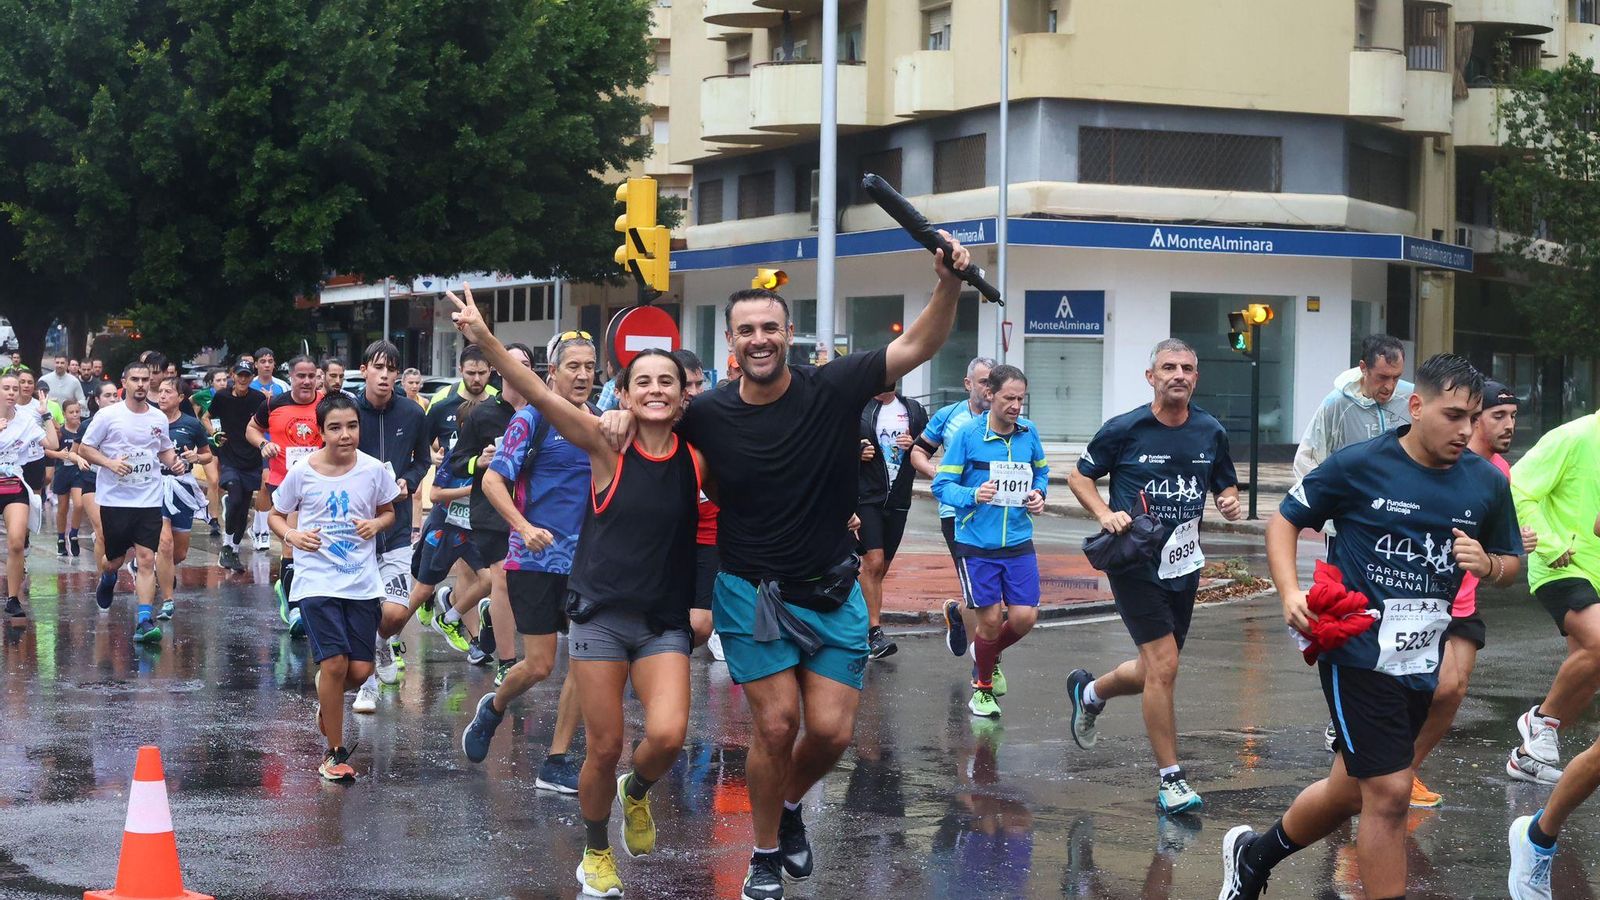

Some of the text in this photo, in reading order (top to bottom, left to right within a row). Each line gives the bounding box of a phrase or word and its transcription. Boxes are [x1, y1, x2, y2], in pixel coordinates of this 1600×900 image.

[1167, 233, 1273, 252] MonteAlminara
[1029, 320, 1100, 331] MonteAlminara
[995, 480, 1029, 493] 11011
[1386, 499, 1420, 510] Fundación
[1386, 505, 1411, 515] Unicaja
[1168, 540, 1195, 564] 6939
[1366, 563, 1423, 582] CARRERA
[1366, 572, 1423, 592] URBANA
[1395, 629, 1437, 652] 5232
